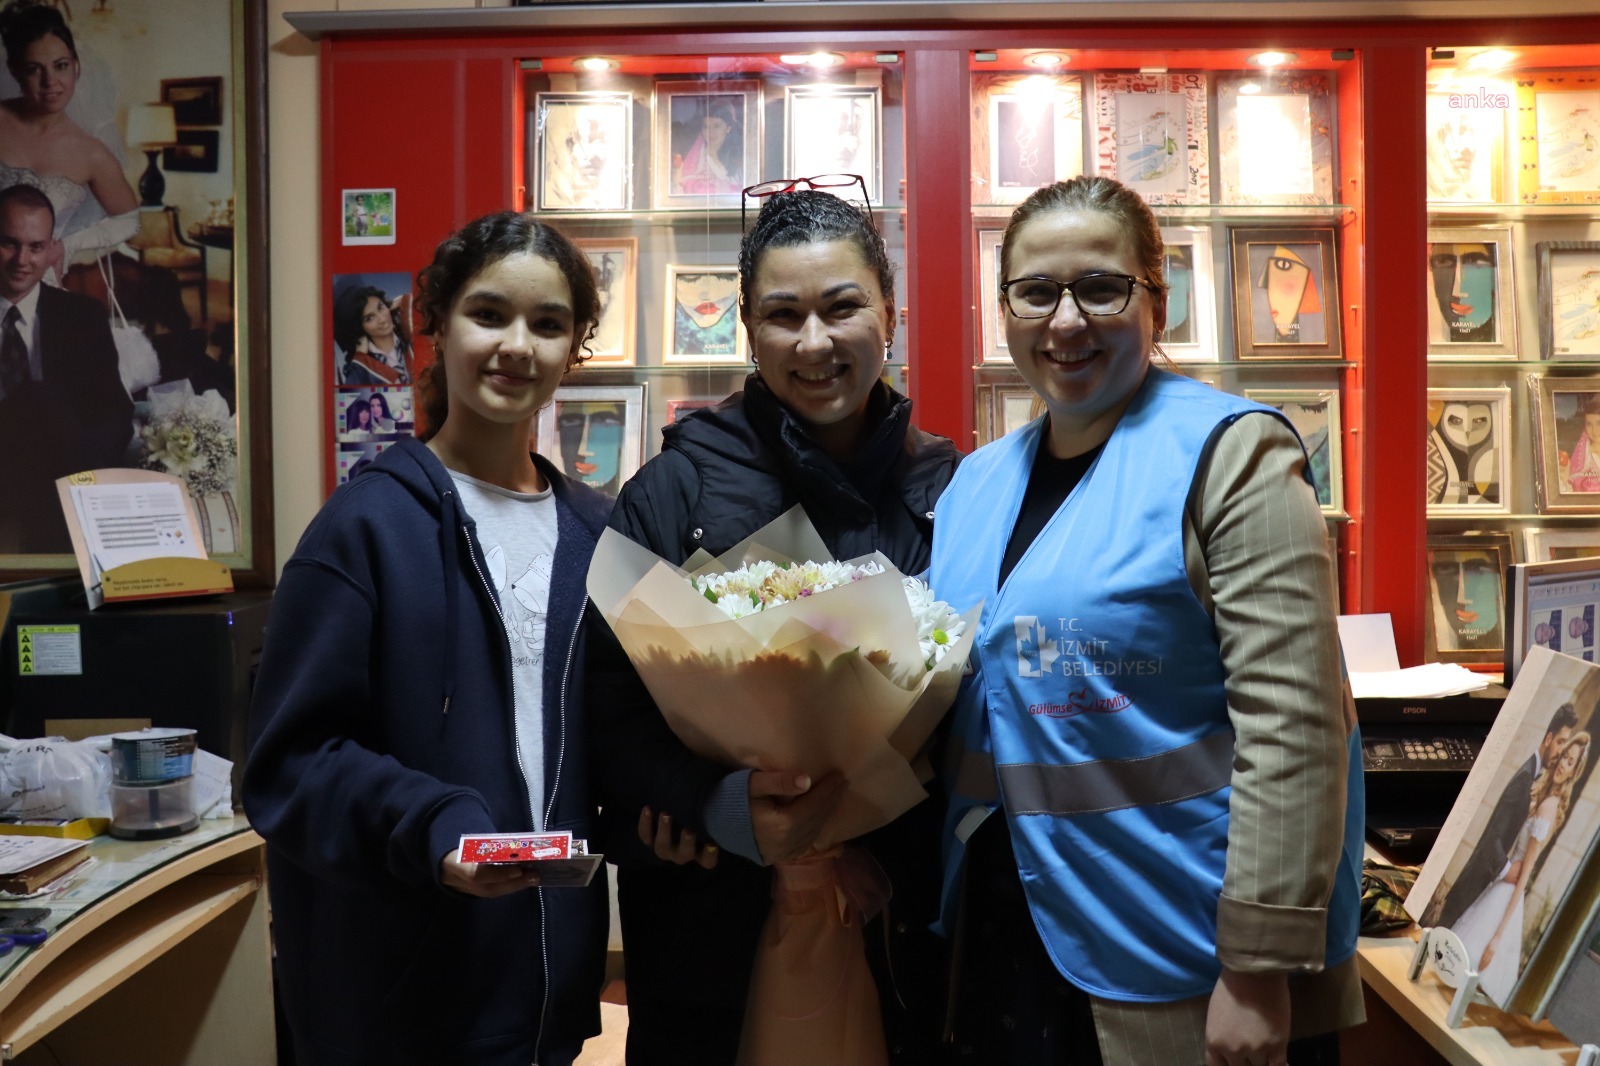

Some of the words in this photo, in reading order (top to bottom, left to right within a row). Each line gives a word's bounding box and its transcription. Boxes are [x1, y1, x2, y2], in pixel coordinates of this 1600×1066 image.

[1058, 617, 1083, 632] T.C.
[1061, 636, 1109, 656] İZMİT
[1062, 656, 1163, 677] BELEDİYESİ
[1028, 702, 1074, 716] Gülümse
